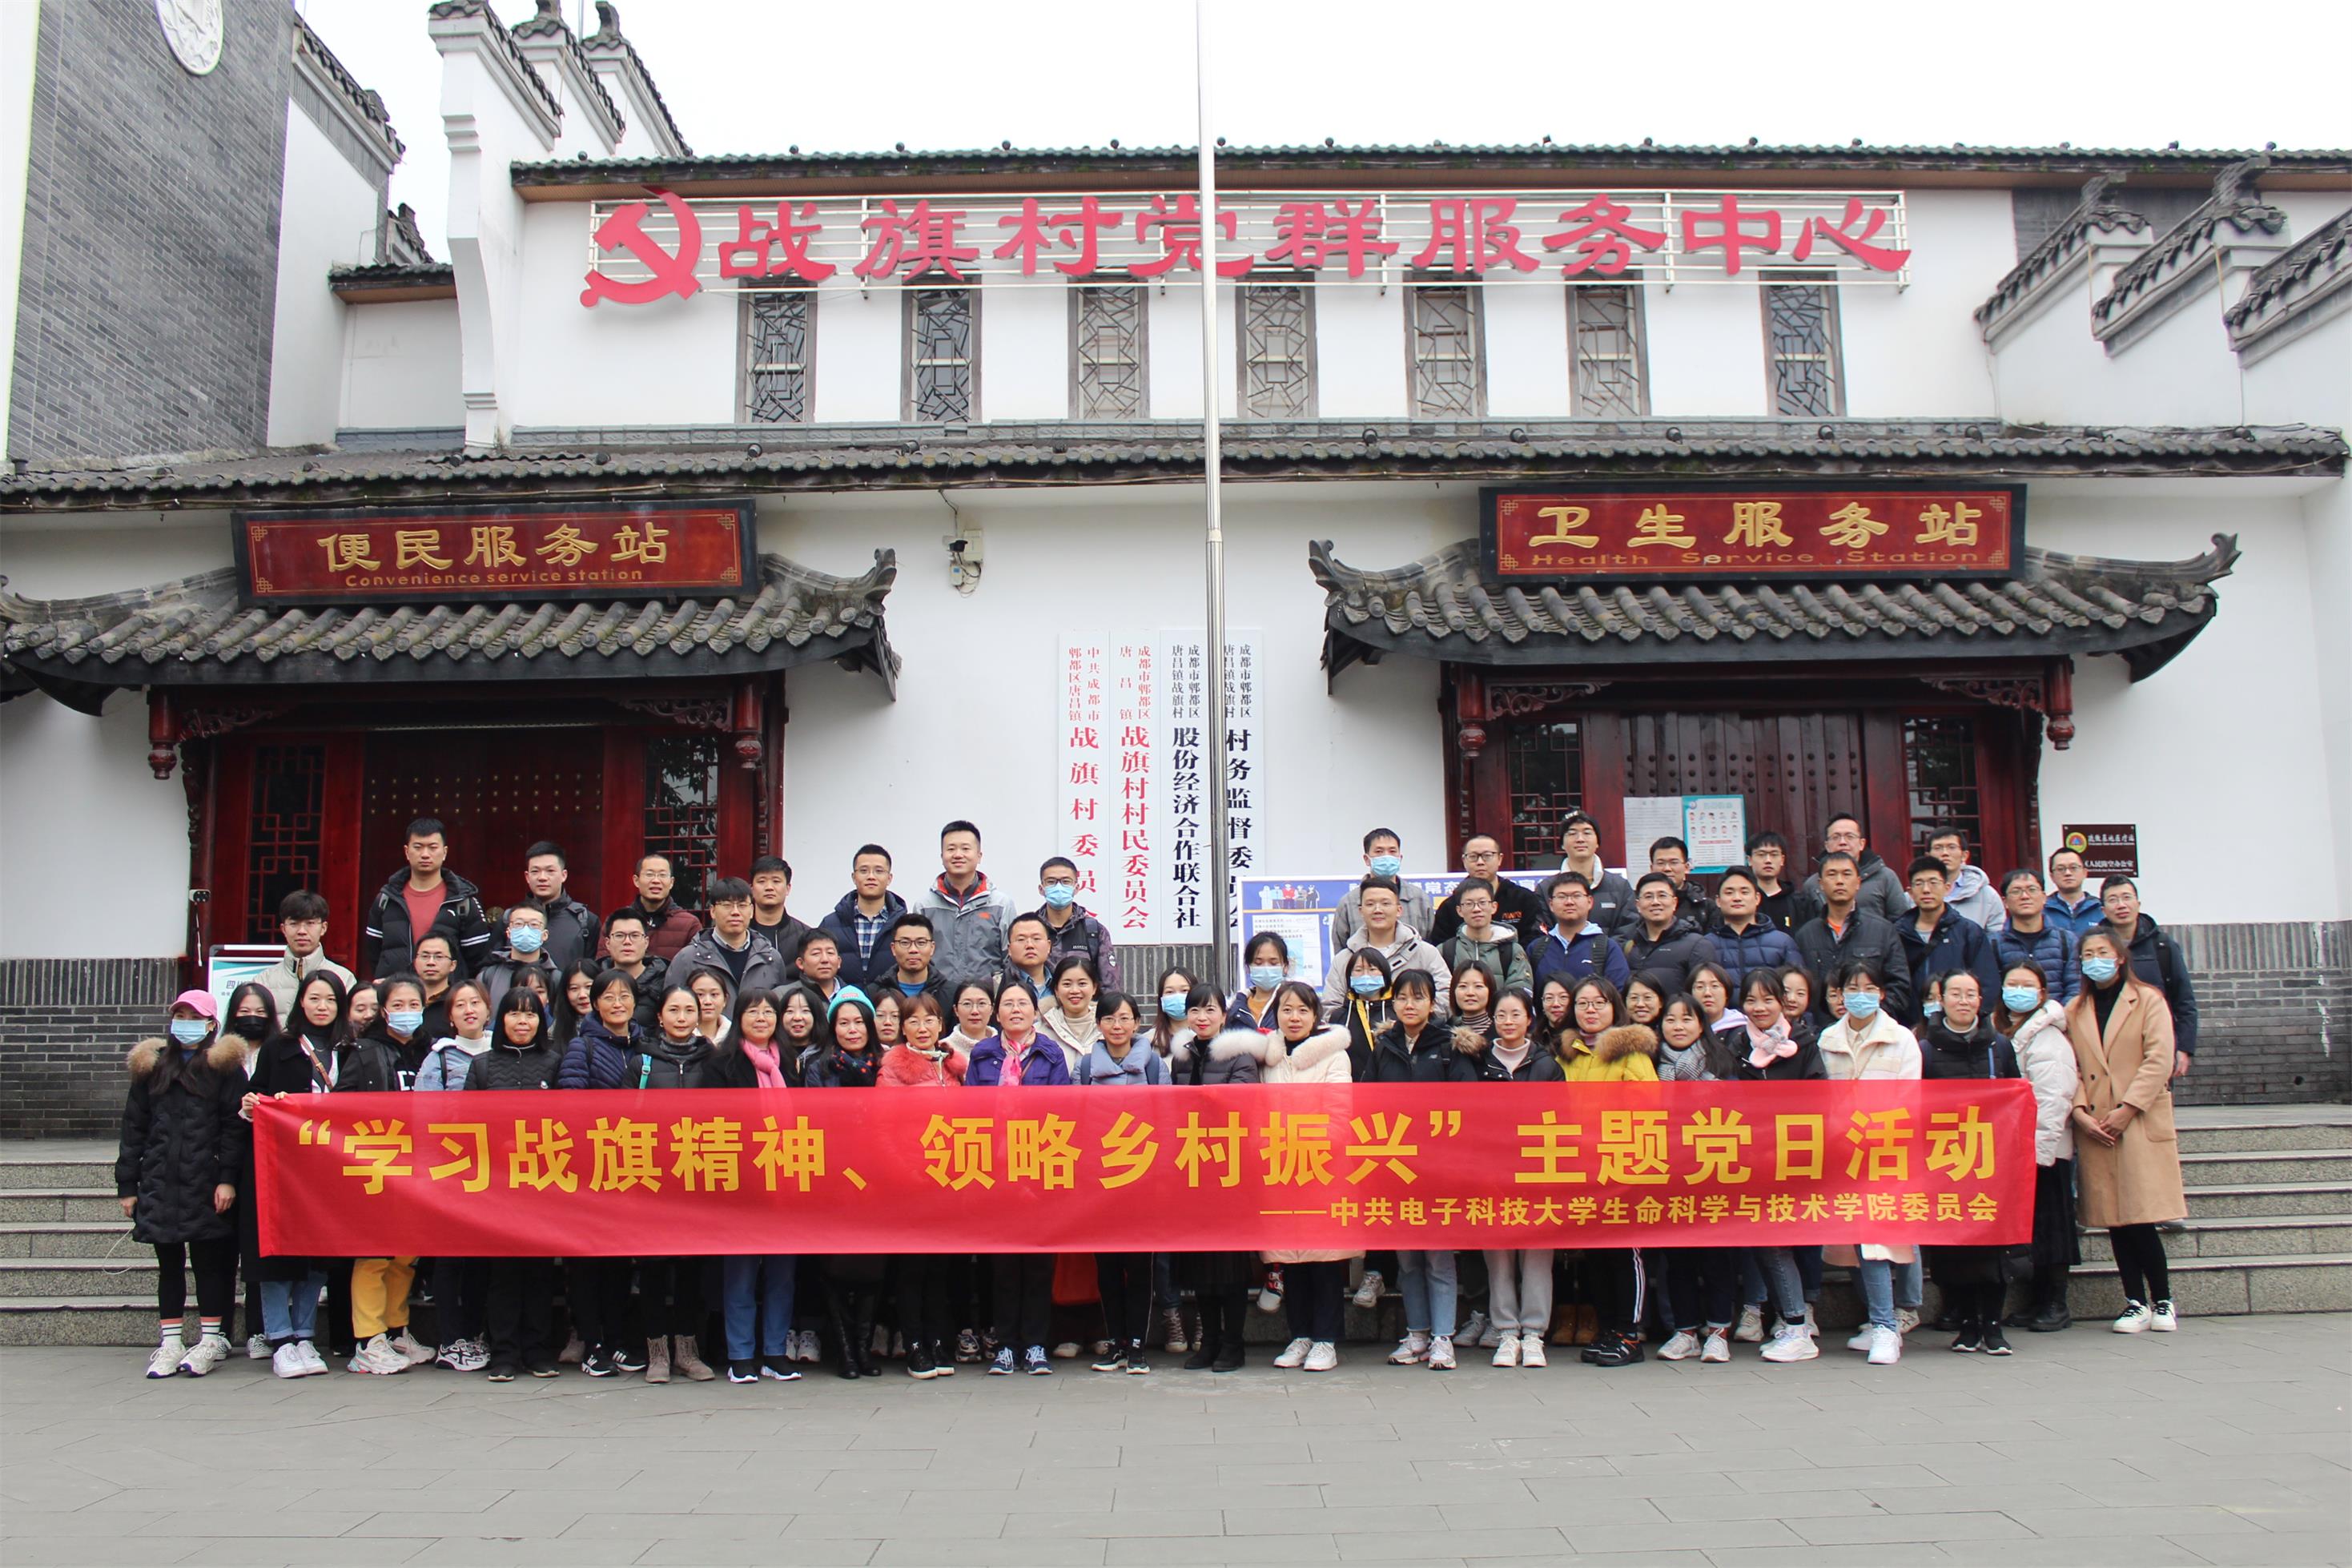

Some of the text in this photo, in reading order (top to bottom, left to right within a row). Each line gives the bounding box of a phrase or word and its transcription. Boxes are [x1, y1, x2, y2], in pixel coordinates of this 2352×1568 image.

[718, 194, 1912, 282] 战旗村党群服务中心
[317, 522, 670, 573] 便民服务站
[1529, 501, 1983, 549] 卫生服务站
[1532, 549, 1978, 565] Health Service Station
[345, 569, 643, 587] Convenience service station
[1069, 646, 1083, 722] 郫都区唐昌镇
[1087, 645, 1100, 722] 中共成都市
[1120, 645, 1133, 721] 唐昌镇
[1138, 645, 1152, 720] 成都市郫都区
[1172, 645, 1184, 719] 唐昌镇战旗村
[1188, 644, 1200, 719] 成都市郫都区
[1240, 644, 1252, 718] 成都市郫都区
[1070, 726, 1100, 918] 战旗村委员
[1120, 726, 1151, 929] 战旗村村民委员会
[1172, 726, 1201, 929] 股份经济合作联合社
